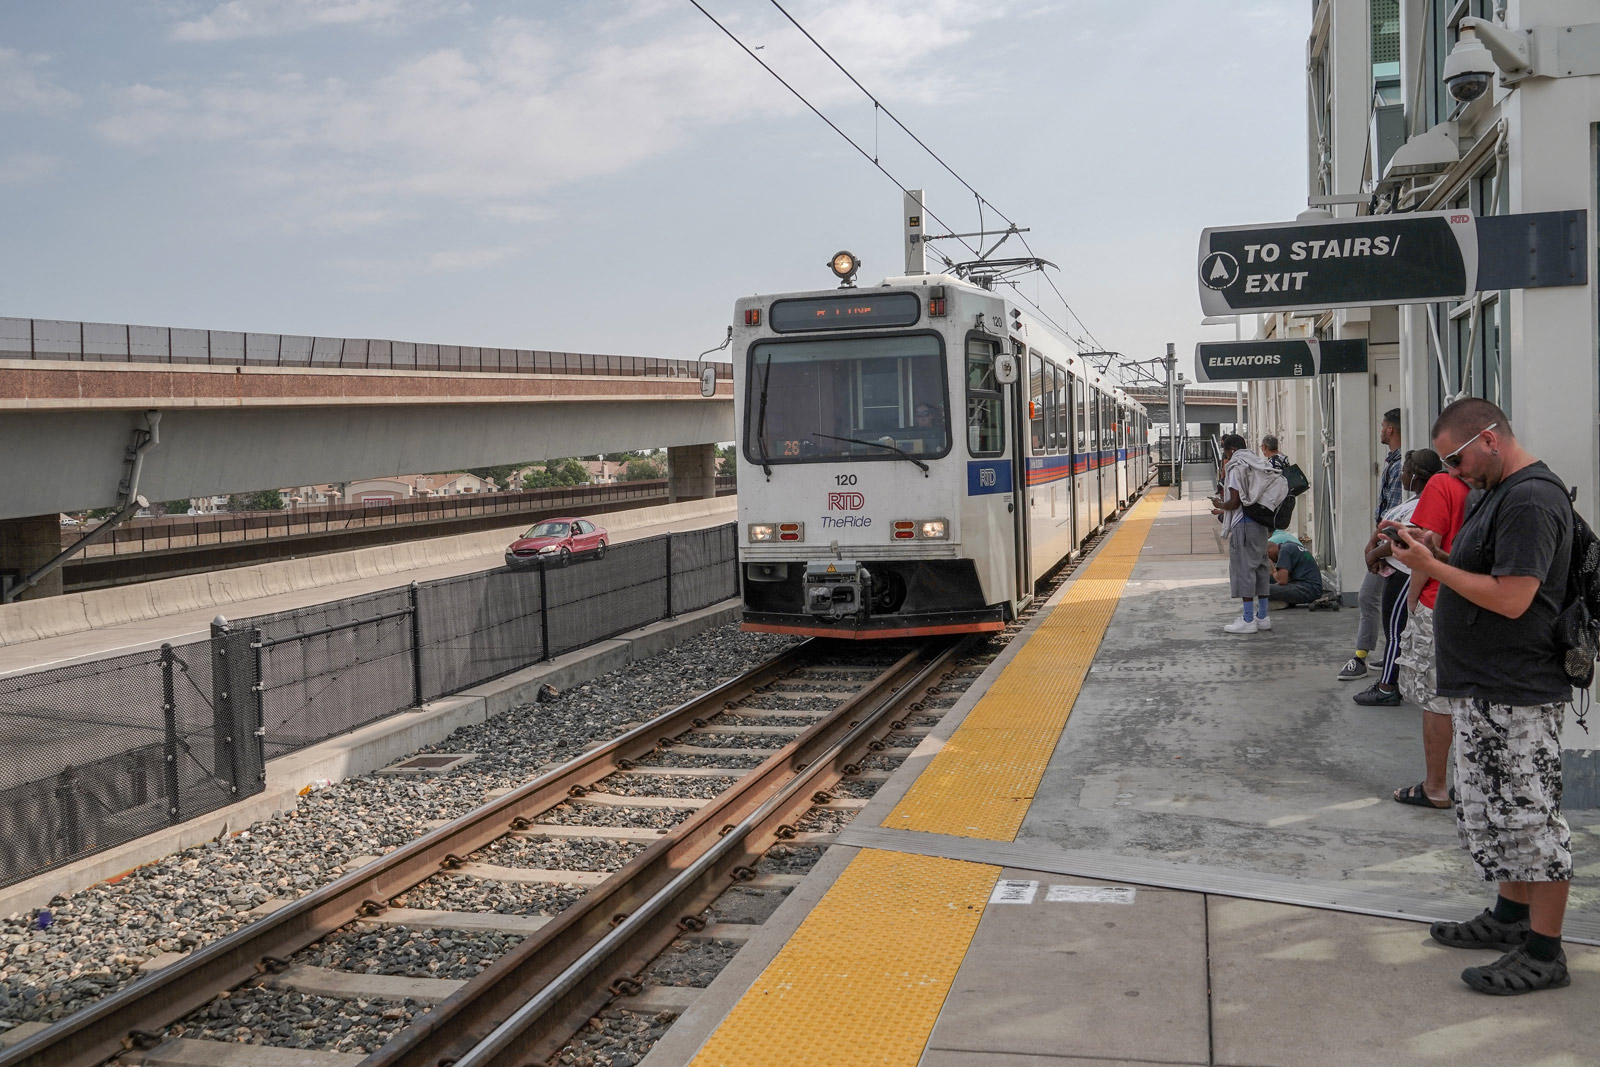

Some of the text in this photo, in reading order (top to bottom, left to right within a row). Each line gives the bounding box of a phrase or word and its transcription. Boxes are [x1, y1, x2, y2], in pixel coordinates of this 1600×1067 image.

[1450, 215, 1470, 224] RTD
[1244, 235, 1401, 263] TO STAIRS/
[1245, 271, 1308, 293] EXIT
[992, 316, 1003, 327] 120
[1208, 354, 1281, 367] ELEVATORS
[834, 474, 857, 486] 120
[979, 467, 997, 487] RTD
[828, 492, 865, 511] RTD
